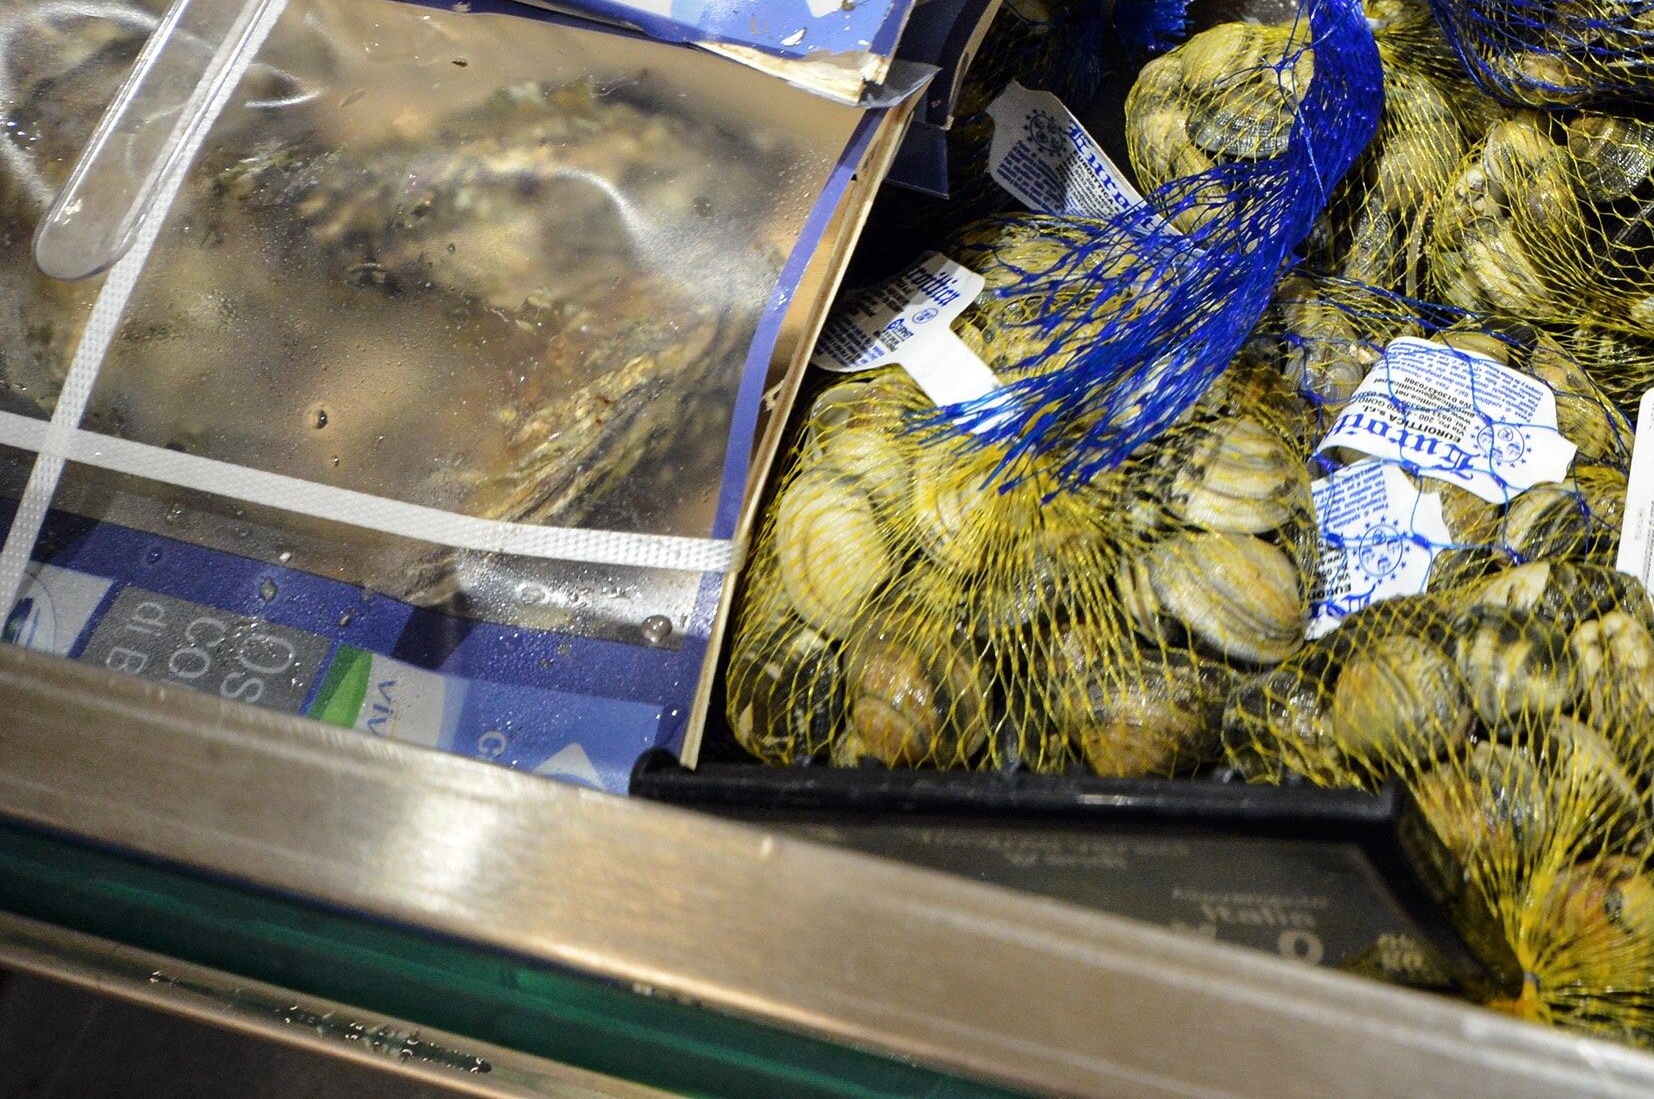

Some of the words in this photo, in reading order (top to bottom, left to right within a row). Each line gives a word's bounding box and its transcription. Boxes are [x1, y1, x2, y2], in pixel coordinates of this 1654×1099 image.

[1358, 394, 1385, 407] GORO
[1393, 388, 1472, 424] www.euroittica.net
[1361, 403, 1387, 418] s.r.l.
[1417, 412, 1435, 424] 200
[1387, 413, 1462, 444] EUROITTICA
[1450, 424, 1466, 437] Via
